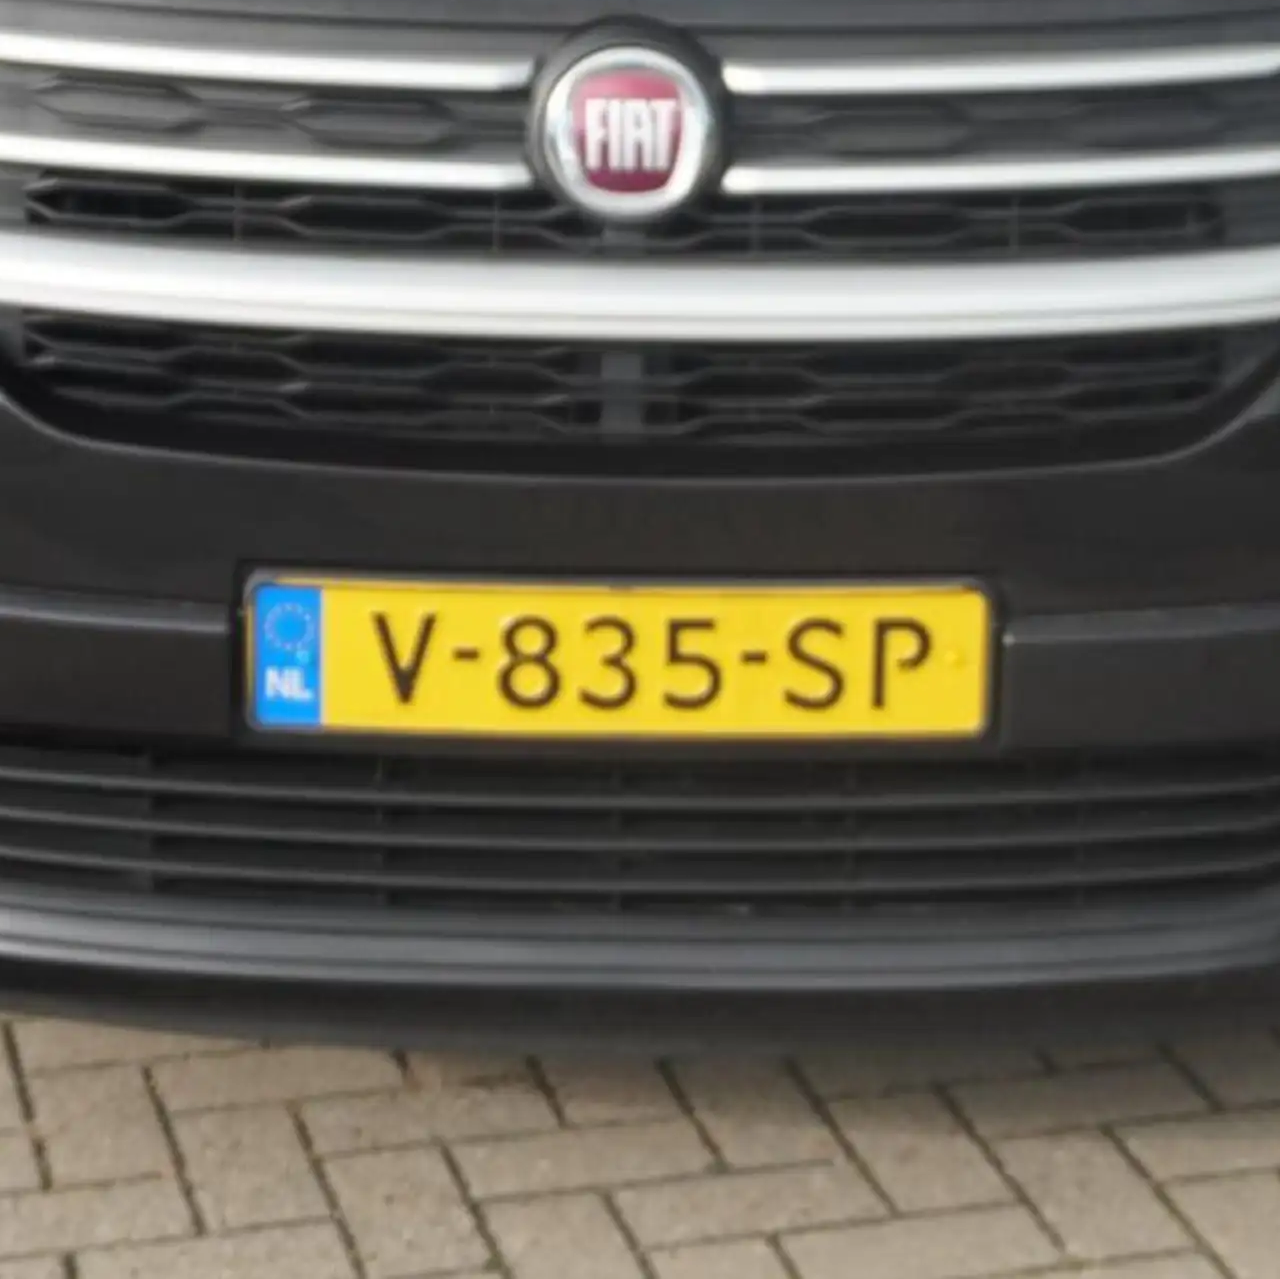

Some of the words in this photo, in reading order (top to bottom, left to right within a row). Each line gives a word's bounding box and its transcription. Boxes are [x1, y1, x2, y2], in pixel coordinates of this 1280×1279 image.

[584, 98, 677, 174] FIAT
[266, 666, 313, 702] NL
[372, 611, 934, 712] V-835-SP
